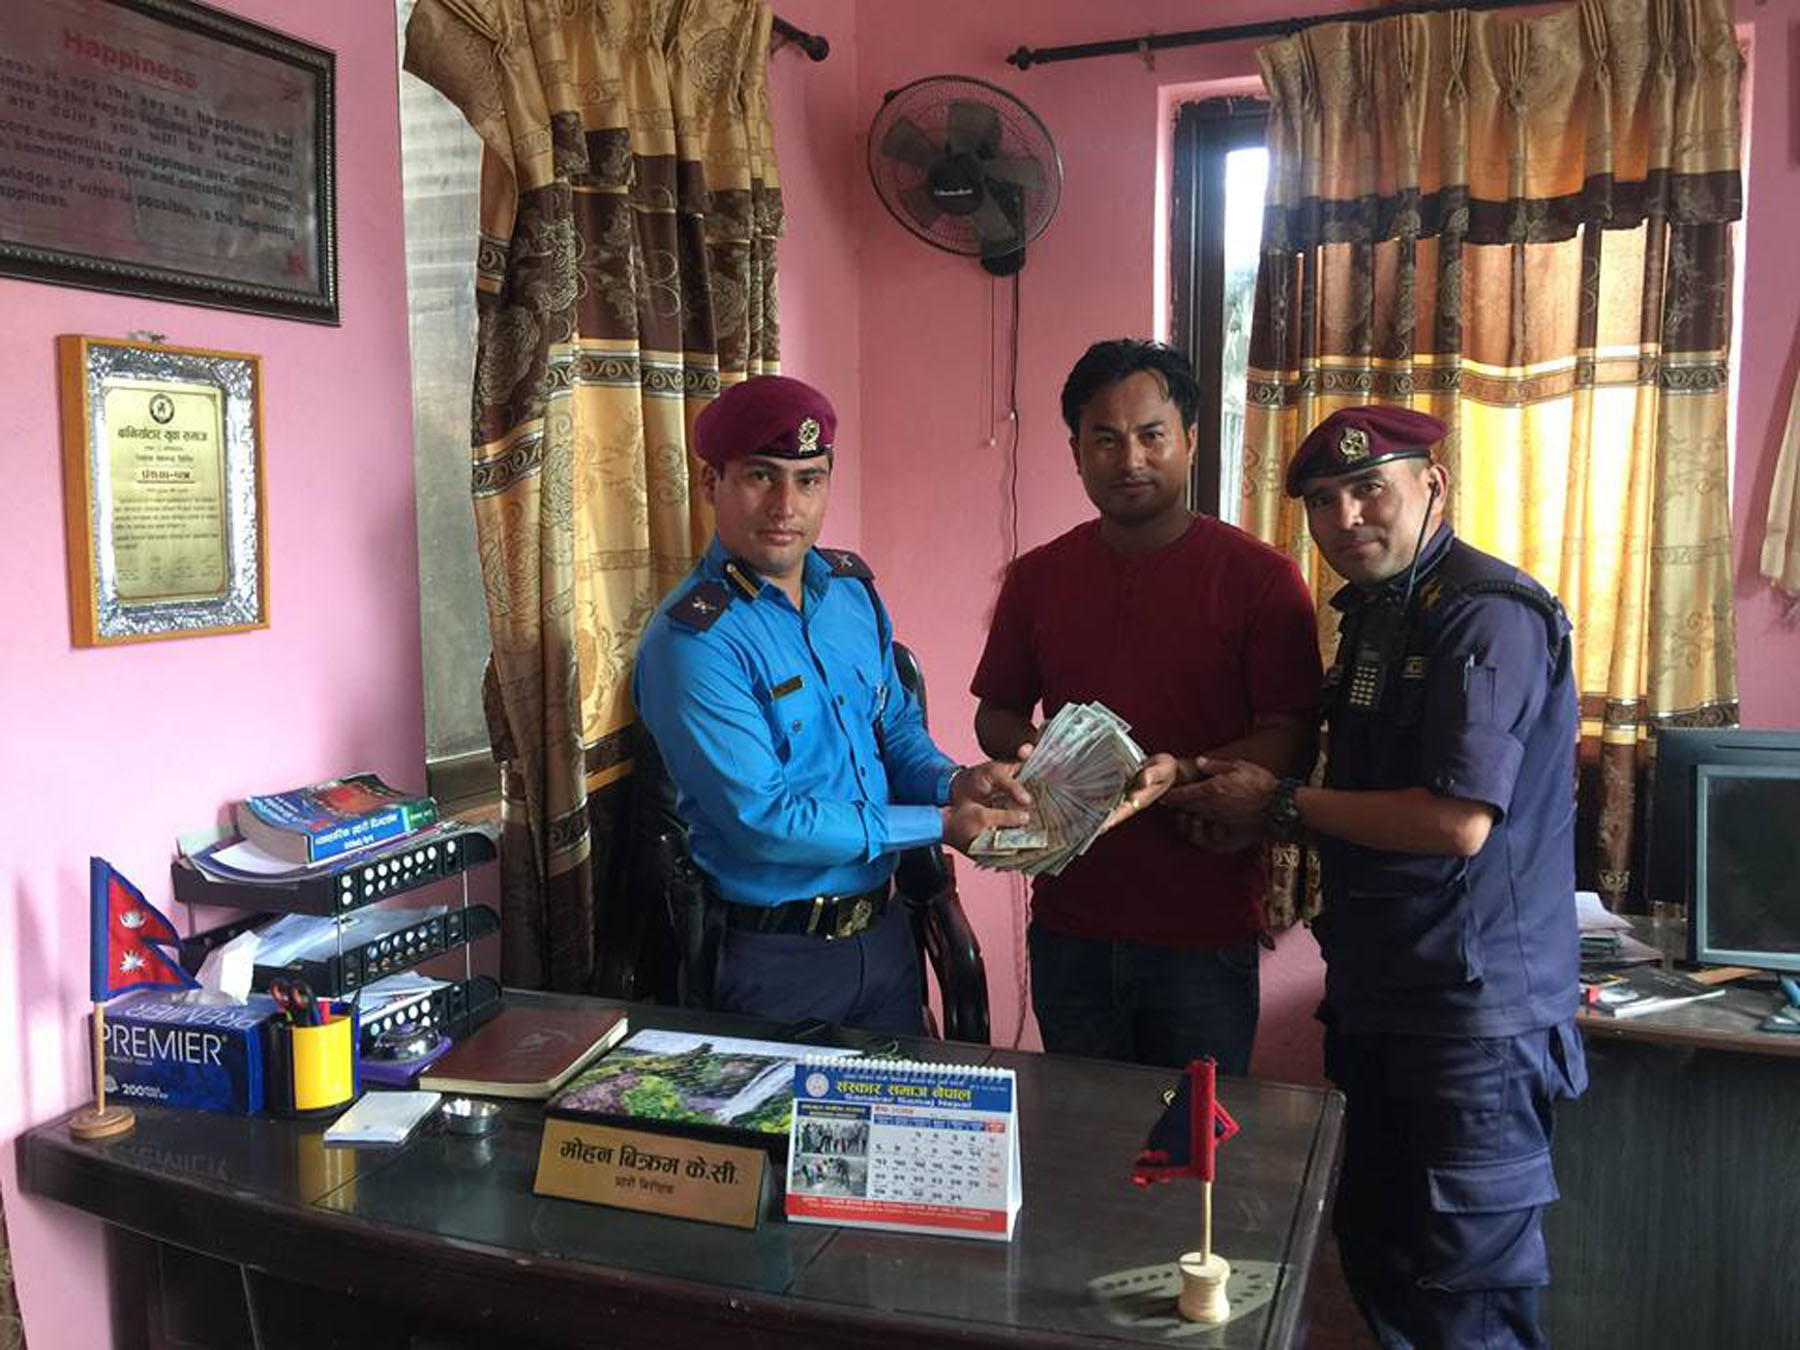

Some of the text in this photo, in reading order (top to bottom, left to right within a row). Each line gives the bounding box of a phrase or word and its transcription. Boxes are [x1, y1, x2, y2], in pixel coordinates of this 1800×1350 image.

[62, 24, 198, 90] Happiness
[102, 1022, 223, 1067] PREMIER
[121, 1083, 146, 1098] 200
[560, 1136, 616, 1167] मोहन
